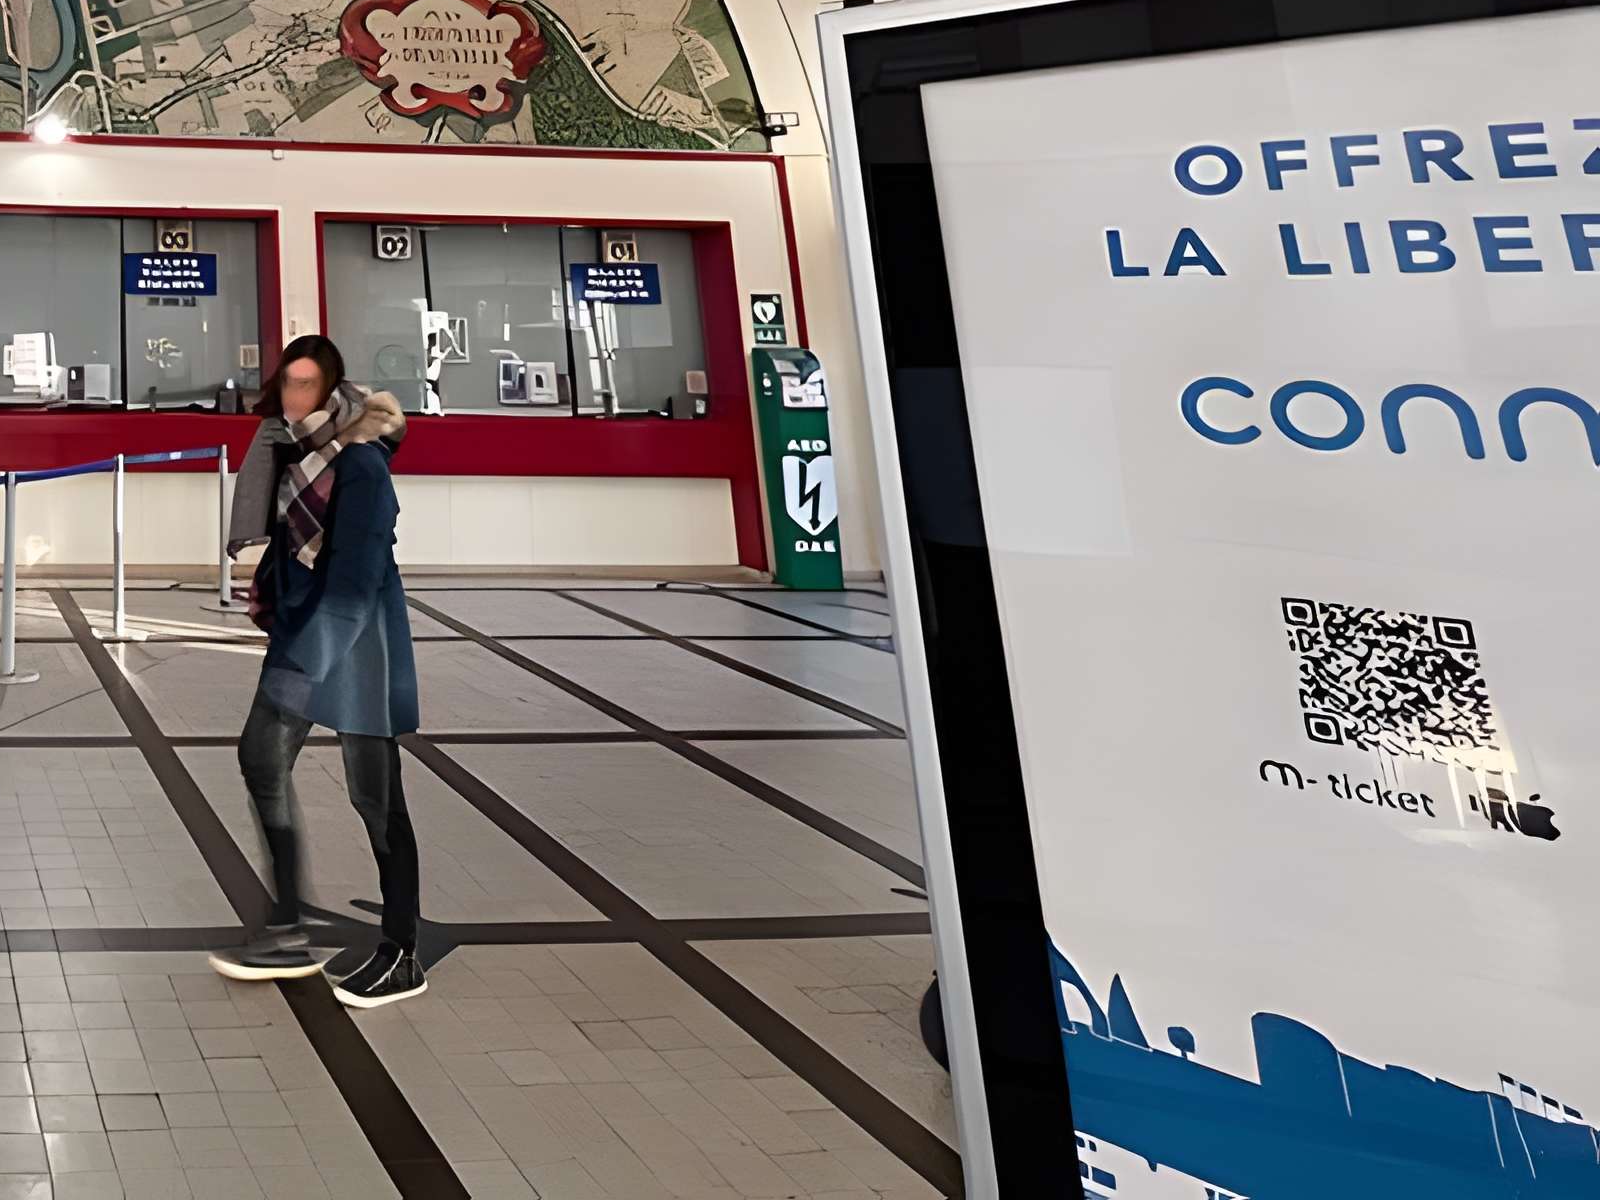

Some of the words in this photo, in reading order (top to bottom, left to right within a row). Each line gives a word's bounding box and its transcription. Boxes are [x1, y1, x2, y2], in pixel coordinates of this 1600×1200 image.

[381, 236, 409, 257] 02
[610, 242, 635, 261] 01
[1105, 227, 1227, 278] LA
